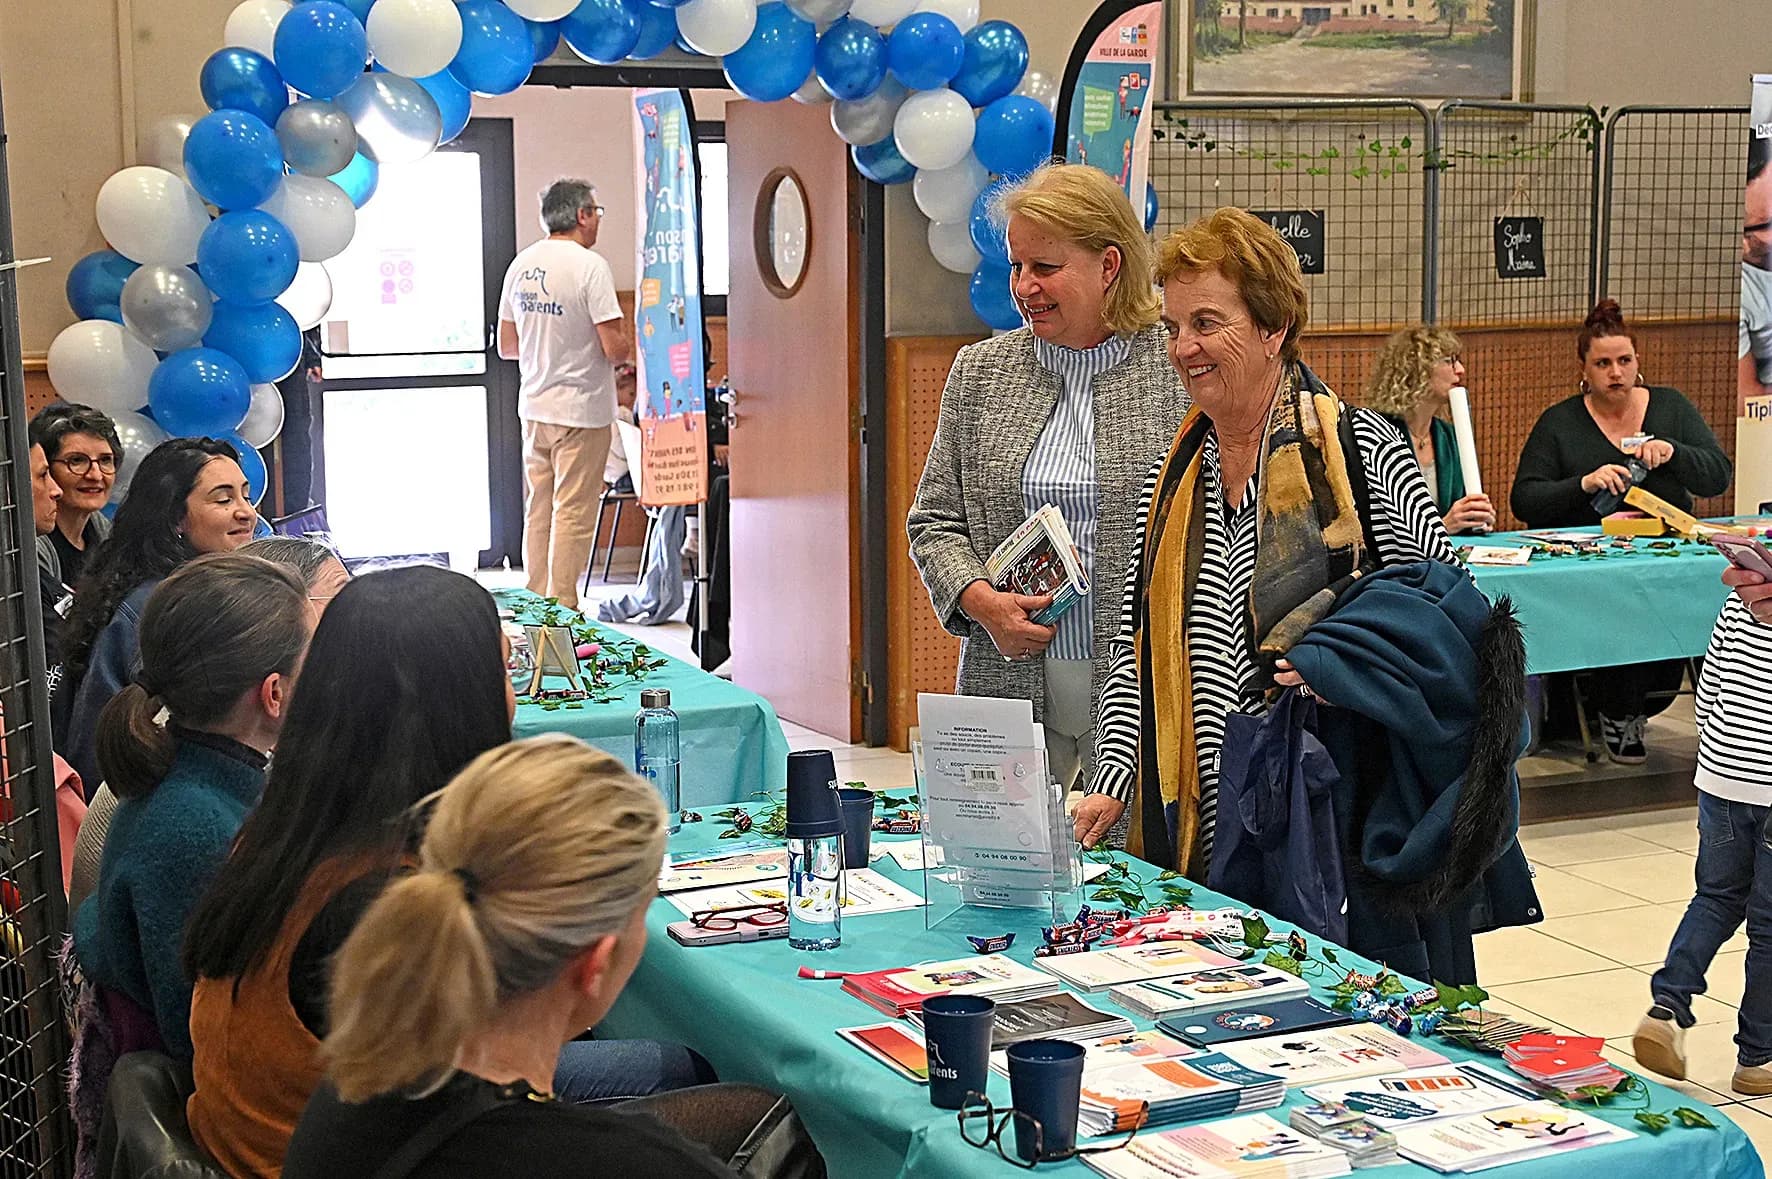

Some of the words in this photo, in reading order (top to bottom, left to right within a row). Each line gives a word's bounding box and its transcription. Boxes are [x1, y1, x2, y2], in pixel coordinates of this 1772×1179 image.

[1100, 48, 1112, 57] VILLE
[1113, 48, 1119, 57] DE
[1120, 48, 1126, 57] LA
[1127, 49, 1147, 58] GARDE
